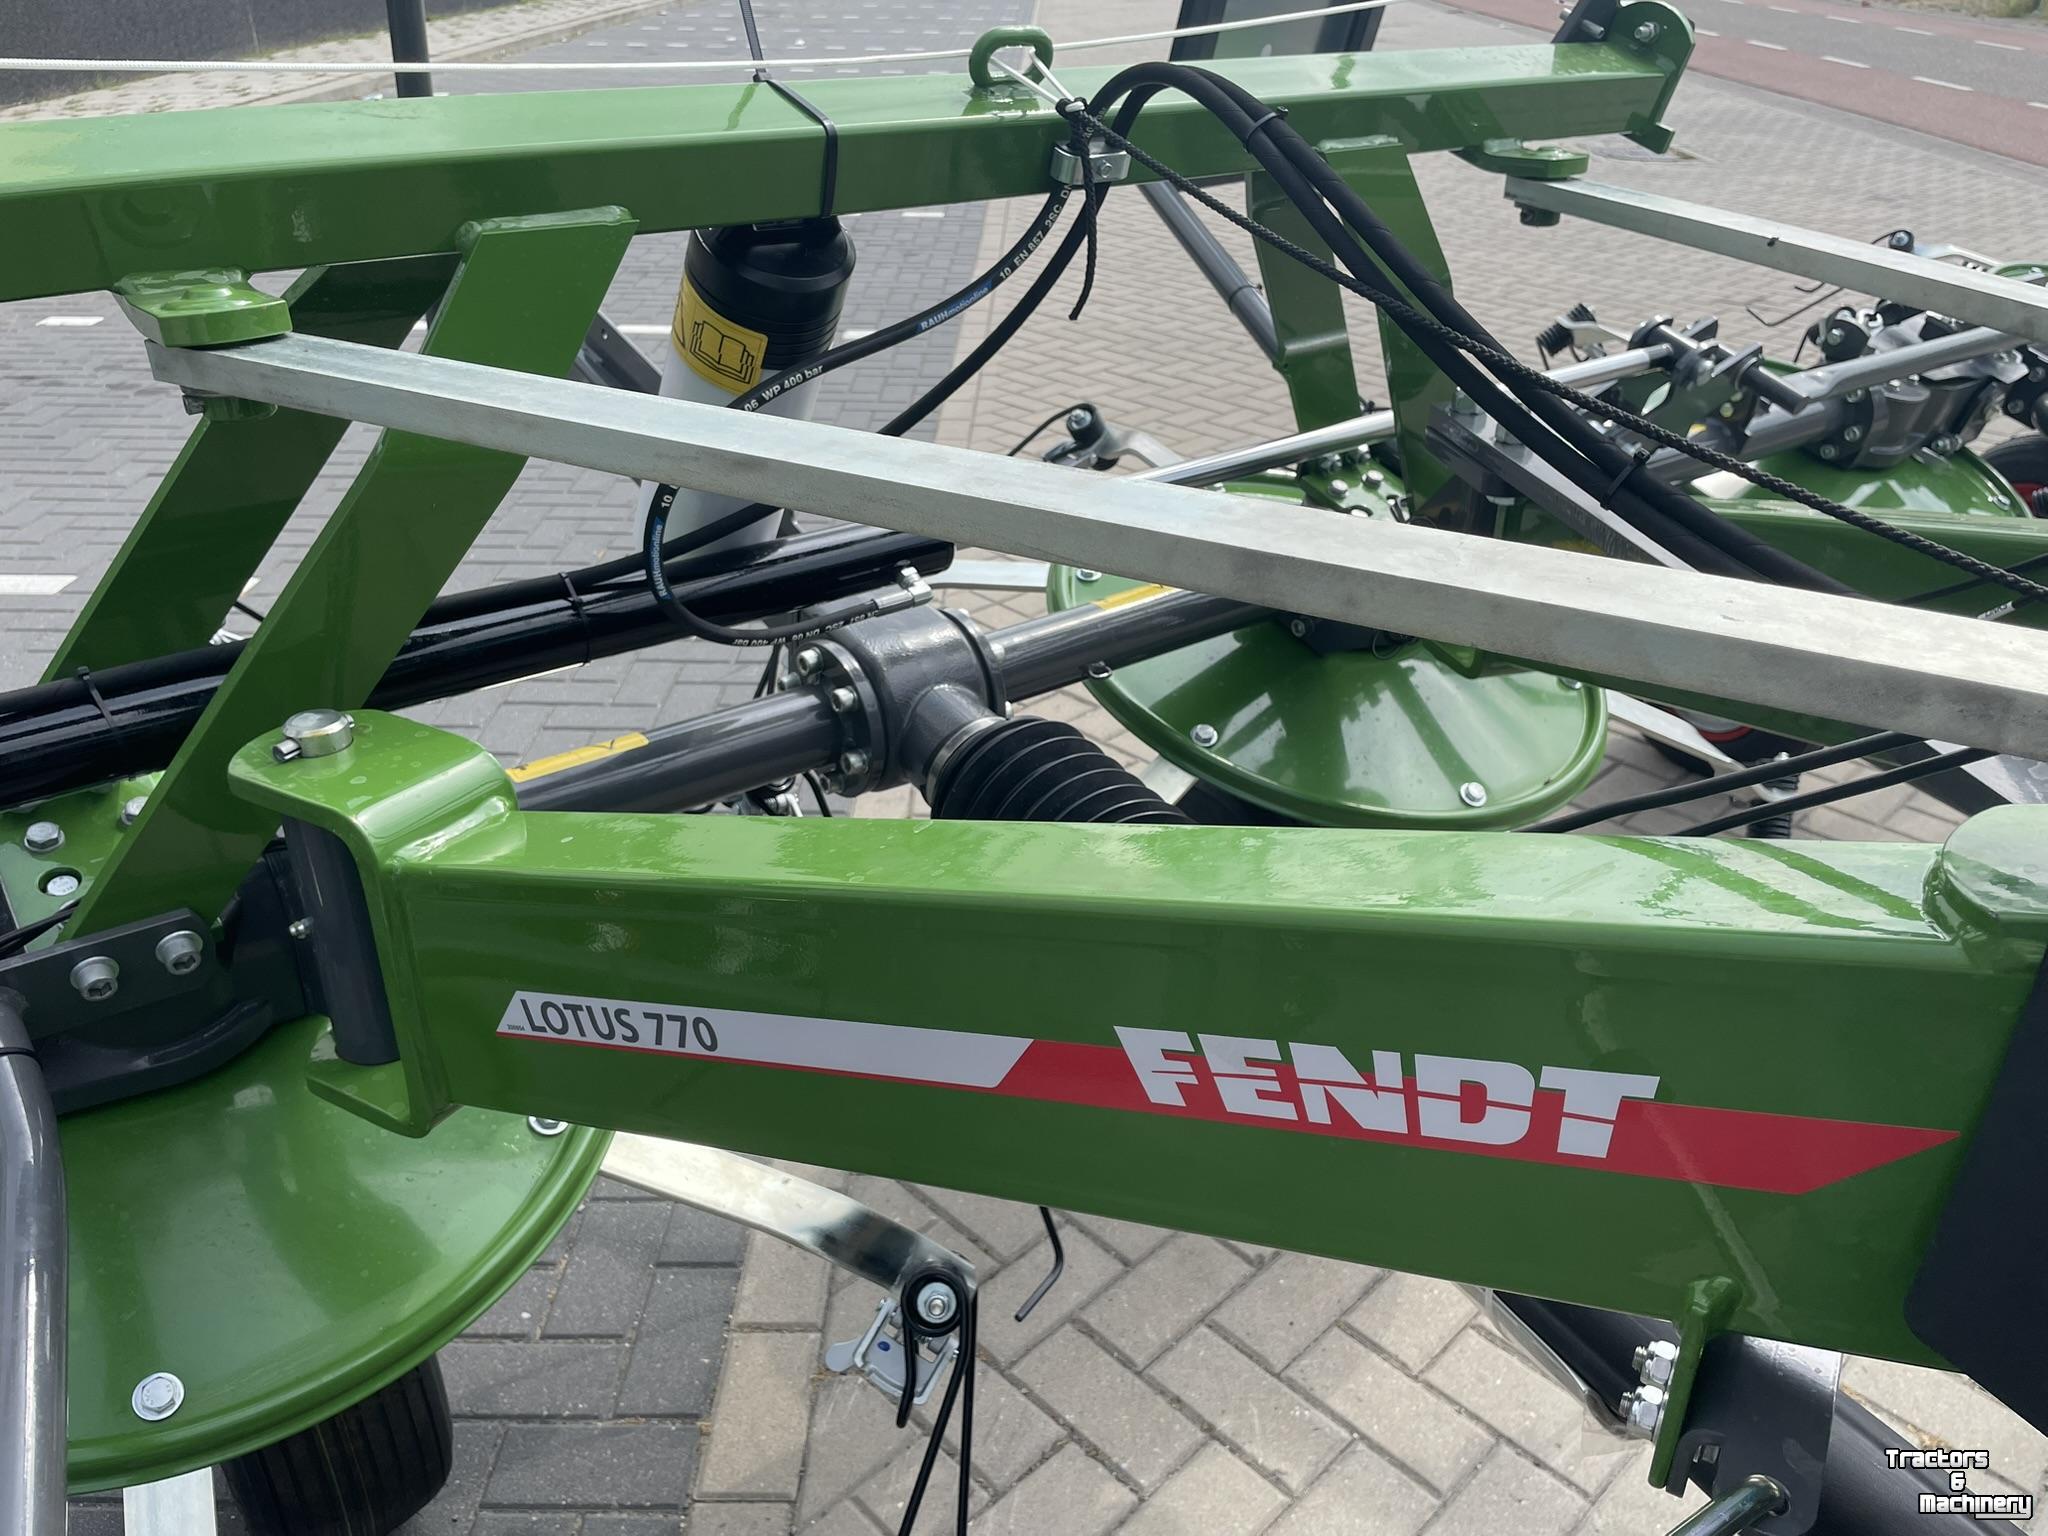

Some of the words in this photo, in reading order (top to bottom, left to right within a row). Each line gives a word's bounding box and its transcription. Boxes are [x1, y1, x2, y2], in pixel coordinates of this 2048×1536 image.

[920, 286, 990, 331] RAUHmotionline
[999, 266, 1012, 280] 10
[1013, 250, 1029, 267] EN
[1027, 229, 1045, 252] 857
[1044, 203, 1063, 227] 2SC
[743, 399, 759, 412] 06
[761, 384, 782, 401] WP
[783, 373, 804, 389] 400
[804, 365, 824, 379] bar
[661, 494, 673, 508] 10
[520, 998, 640, 1044] LOTUS
[642, 1011, 719, 1052] 770
[1113, 1025, 1661, 1159] FENDT
